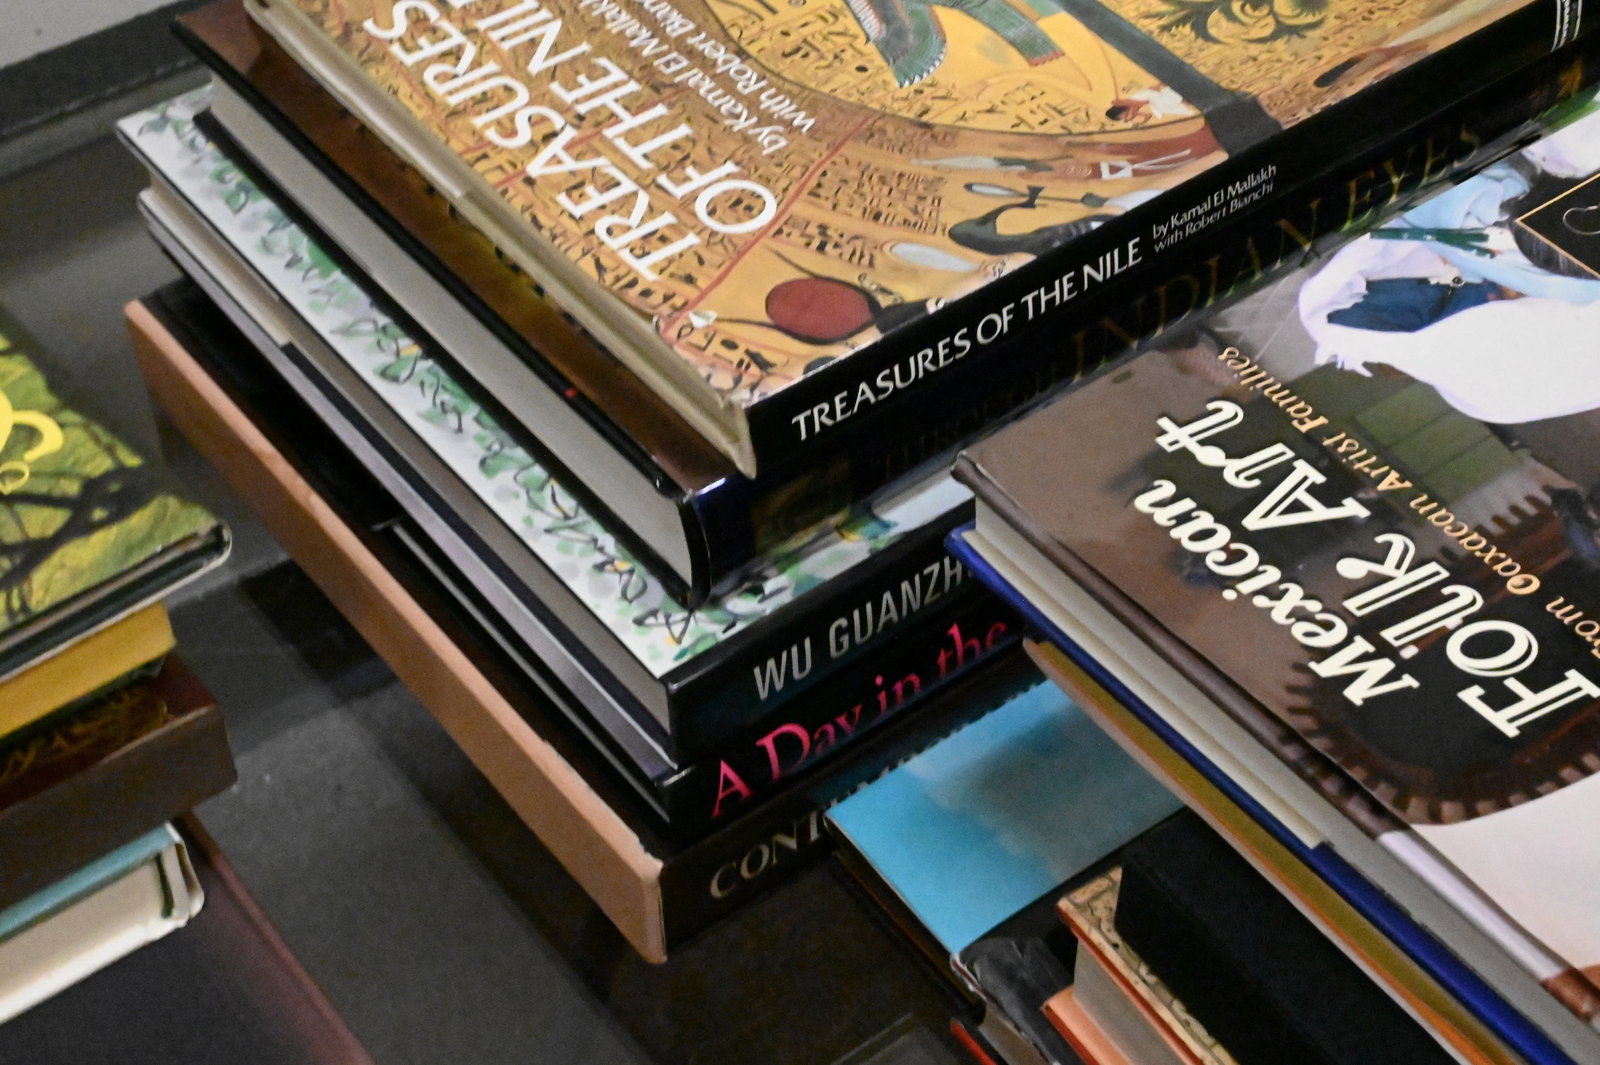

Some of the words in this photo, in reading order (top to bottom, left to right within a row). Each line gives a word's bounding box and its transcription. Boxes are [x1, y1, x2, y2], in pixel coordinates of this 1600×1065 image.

[653, 51, 690, 75] El
[673, 68, 758, 133] Kamal
[687, 31, 768, 95] Robert
[362, 0, 701, 282] TREASURES
[548, 56, 693, 170] THE
[747, 124, 788, 156] by
[759, 87, 816, 134] with
[656, 160, 778, 235] OF
[1152, 223, 1169, 240] by
[1170, 195, 1211, 230] Kamal
[1213, 188, 1224, 208] El
[1226, 164, 1277, 200] Mallakh
[1154, 228, 1184, 253] with
[1185, 205, 1227, 238] Robert
[1229, 179, 1274, 214] Bianchi
[791, 326, 972, 442] TREASURES
[976, 301, 1017, 345] OF
[1020, 270, 1078, 321] THE
[1083, 236, 1144, 293] NILE
[1217, 346, 1329, 435] Families
[1155, 400, 1371, 531] Art
[1322, 431, 1413, 493] Artist
[1411, 493, 1541, 595] Oaxacan
[753, 637, 813, 701] WU
[828, 555, 974, 658] GUANZH
[1134, 479, 1420, 707] Mexican
[1336, 532, 1600, 738] Folk
[710, 758, 754, 820] A
[874, 674, 922, 717] in
[936, 621, 1008, 678] the
